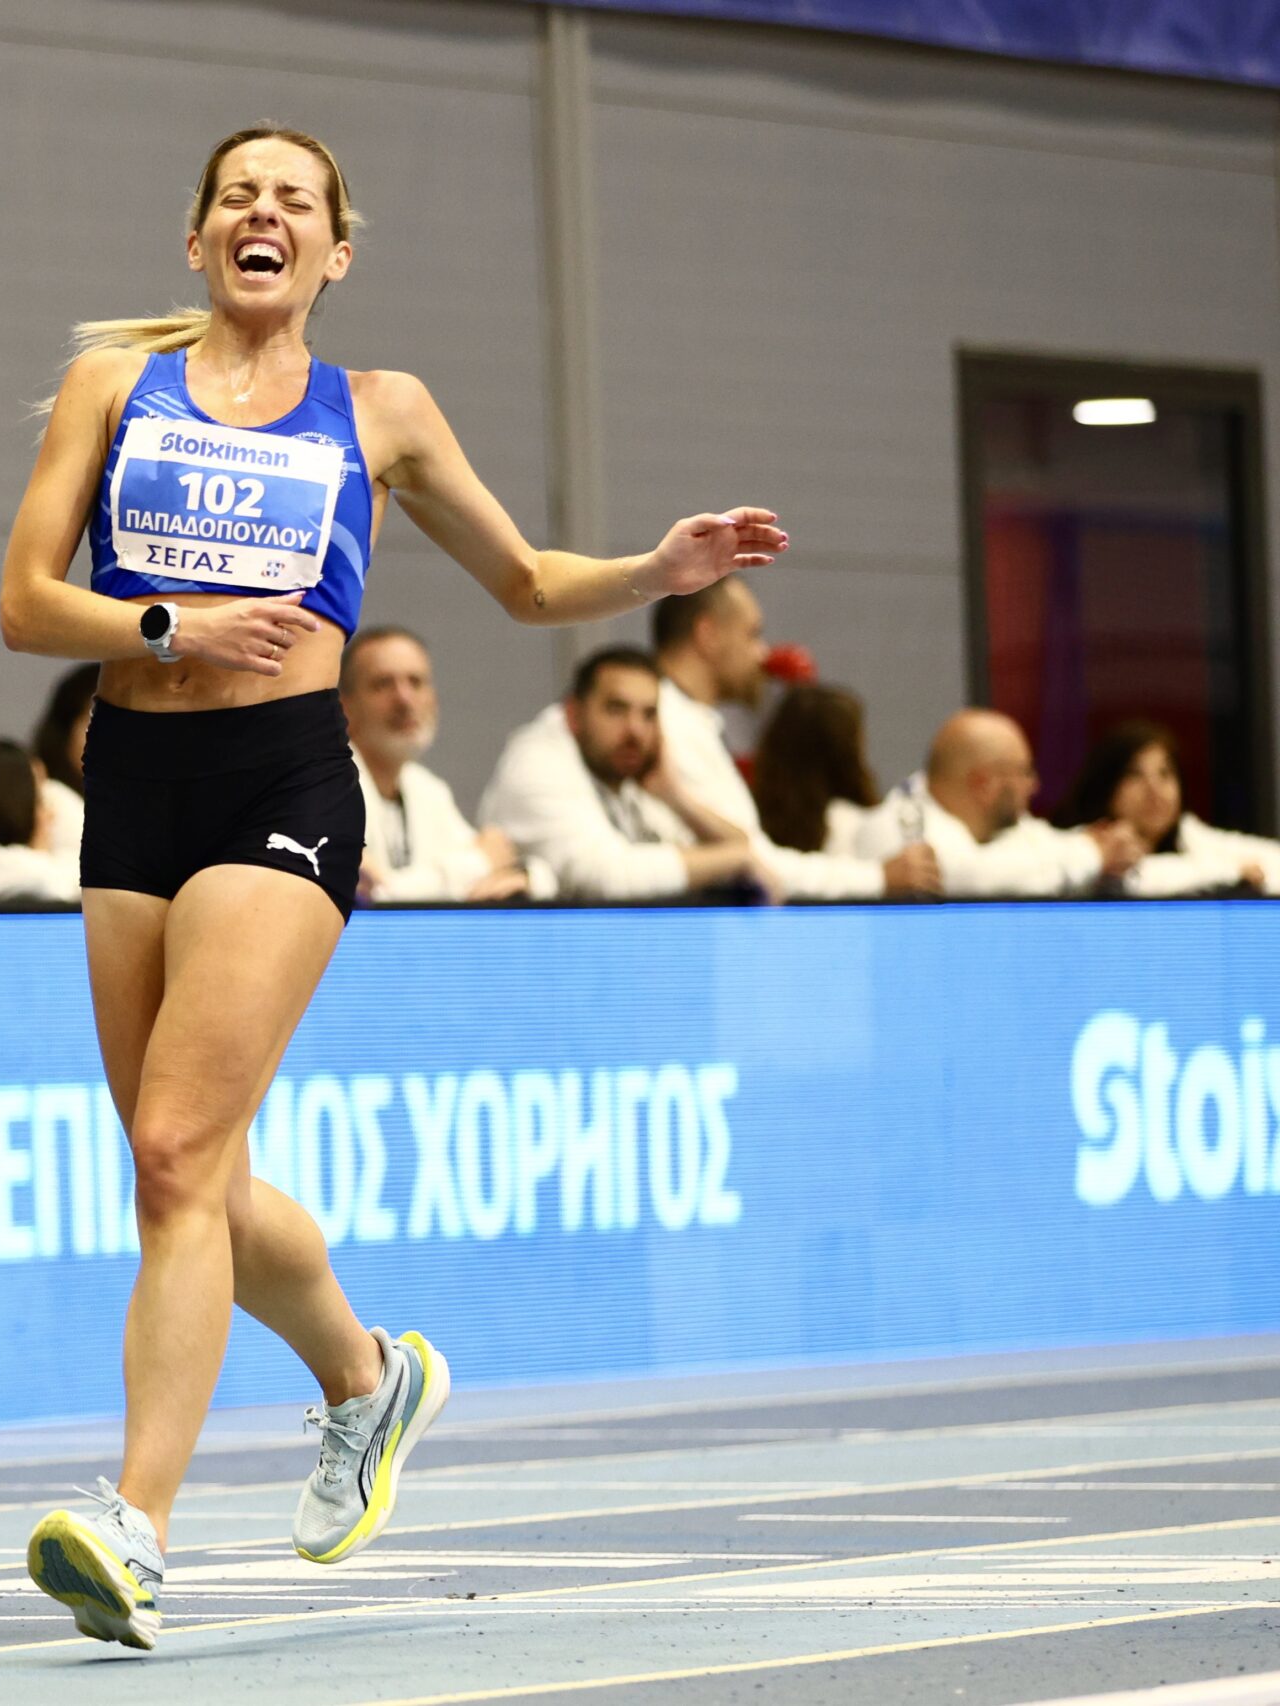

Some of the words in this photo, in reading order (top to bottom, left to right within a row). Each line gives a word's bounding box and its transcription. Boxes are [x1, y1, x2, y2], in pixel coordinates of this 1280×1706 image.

[160, 432, 289, 468] Stoiximan
[178, 471, 265, 518] 102
[125, 508, 313, 550] ΠΑΠΑΔΟΠΟΥΛΟΥ
[146, 543, 235, 575] ΣΕΓΑΣ
[1070, 1007, 1280, 1207] Stoi
[402, 1062, 743, 1241] ΧΟΡΗΓΟΣ
